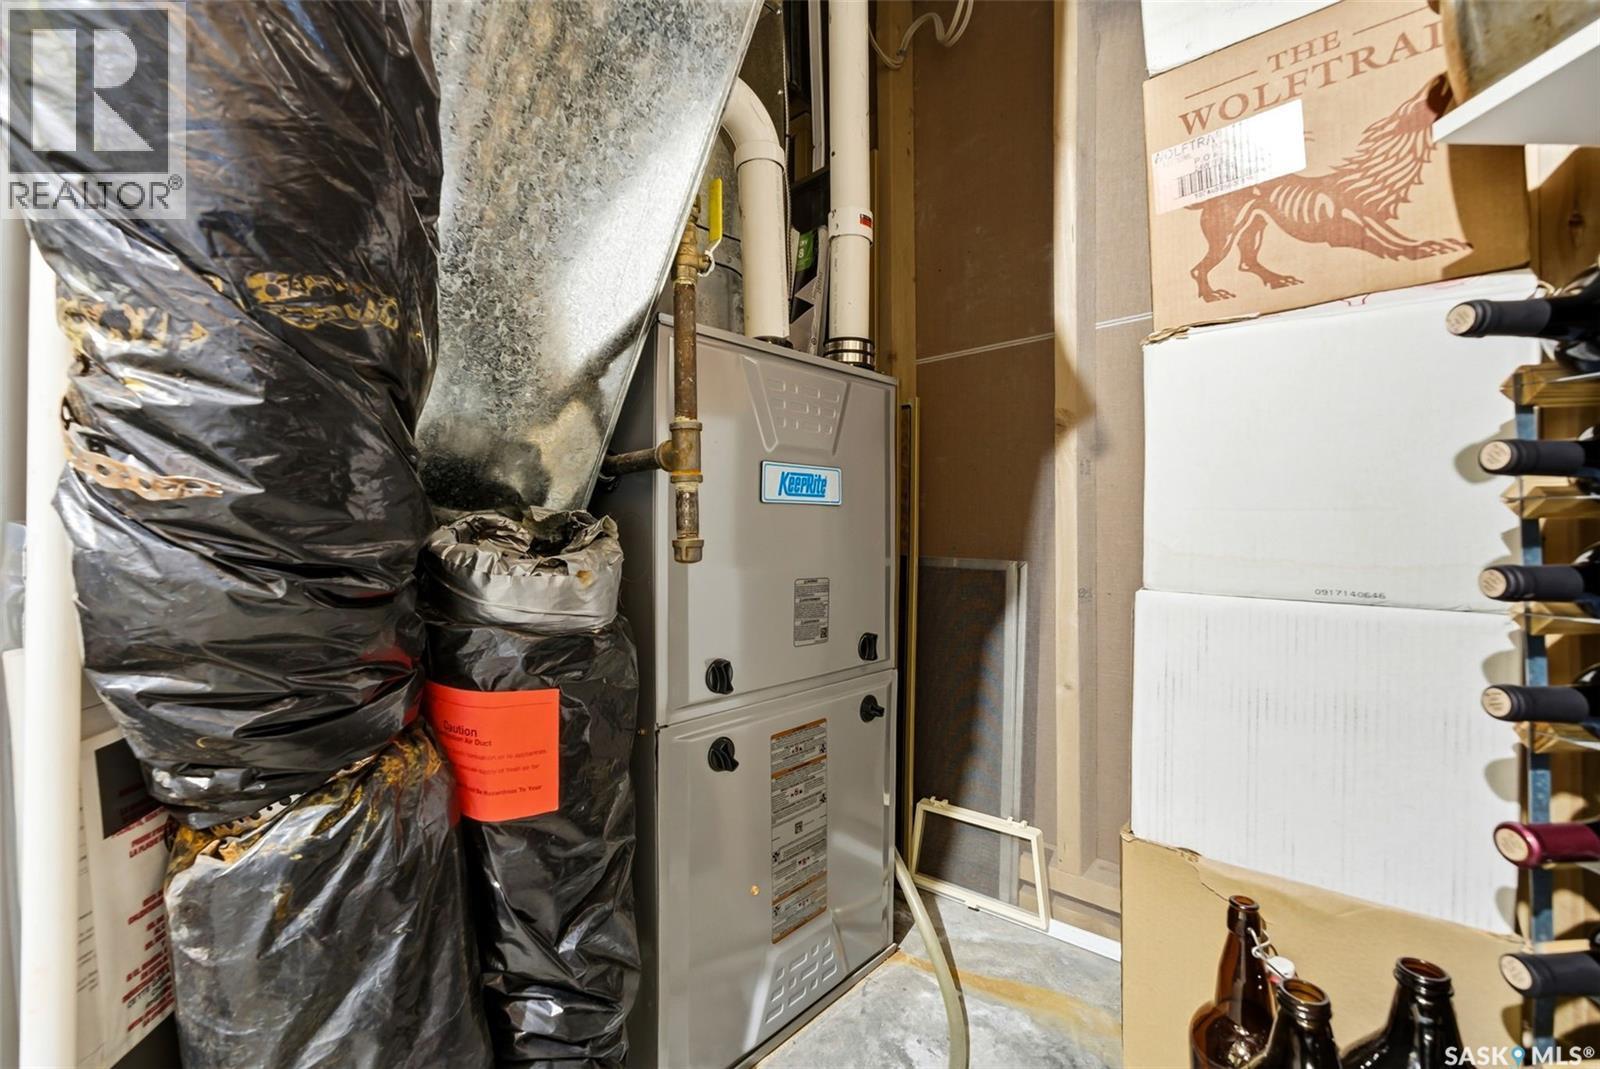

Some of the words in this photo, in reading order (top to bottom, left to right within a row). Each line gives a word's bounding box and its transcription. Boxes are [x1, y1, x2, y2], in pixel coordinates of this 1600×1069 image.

[1267, 30, 1341, 71] THE
[1314, 588, 1387, 600] 0917140646
[443, 719, 478, 738] Caution
[474, 739, 492, 747] Duct
